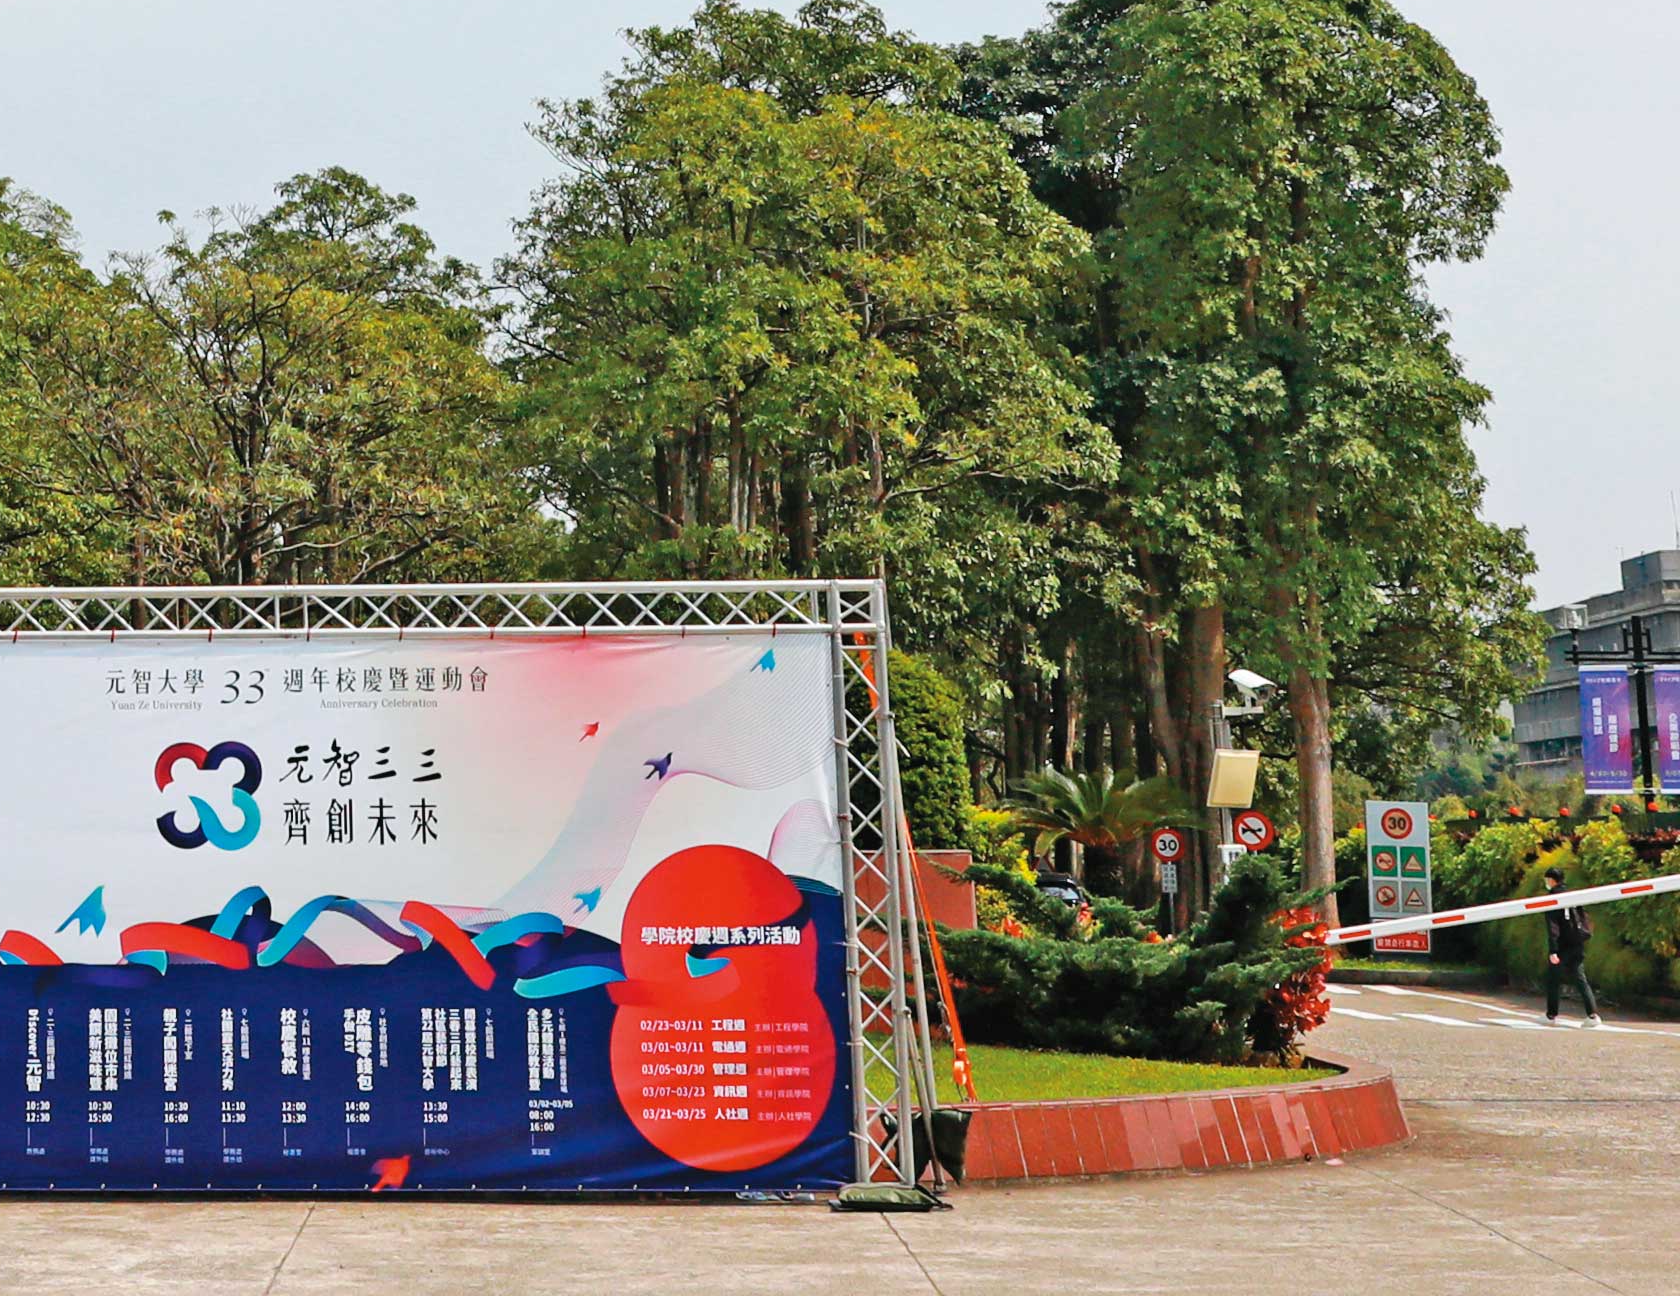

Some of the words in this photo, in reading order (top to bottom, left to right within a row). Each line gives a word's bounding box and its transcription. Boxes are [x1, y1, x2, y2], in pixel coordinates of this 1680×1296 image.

[105, 668, 204, 695] 元智大學
[283, 666, 489, 693] 週年校慶暨運動會
[111, 700, 135, 711] Yuan
[138, 700, 150, 710] Ze
[153, 699, 202, 711] University
[320, 698, 378, 710] Anniversary
[381, 698, 438, 708] Celebration
[279, 738, 442, 786] 元智三三
[283, 798, 438, 845] 齊創未來
[1388, 817, 1406, 830] 30
[1159, 839, 1177, 851] 30
[641, 926, 801, 945] 學院校慶週系列活動
[640, 1020, 703, 1031] 02/23~03/11
[712, 1019, 745, 1031] 工程週
[28, 1009, 39, 1057] Discover
[641, 1042, 704, 1053] 03/01~03/11
[642, 1064, 704, 1075] 03/05~03/30
[713, 1063, 747, 1075] 管理週
[26, 1059, 42, 1091] 元智
[642, 1086, 705, 1097] 03/07~03/23
[714, 1085, 748, 1098] 資訊週
[26, 1101, 50, 1110] 10:30
[88, 1101, 112, 1110] 10:30
[164, 1102, 188, 1111] 10:30
[221, 1102, 246, 1111] 11:10
[282, 1102, 306, 1111] 12:00
[345, 1102, 370, 1111] 14:00
[423, 1102, 448, 1111] 13:30
[26, 1113, 50, 1122] 12:30
[88, 1113, 112, 1122] 15:00
[164, 1114, 188, 1123] 16:00
[221, 1114, 246, 1123] 13:30
[282, 1114, 306, 1123] 13:30
[345, 1114, 370, 1123] 16:00
[423, 1114, 448, 1123] 15:00
[529, 1111, 554, 1120] 08:00
[643, 1108, 706, 1120] 03/21~03/25
[715, 1108, 748, 1120] 人社週
[529, 1122, 554, 1132] 16:00
